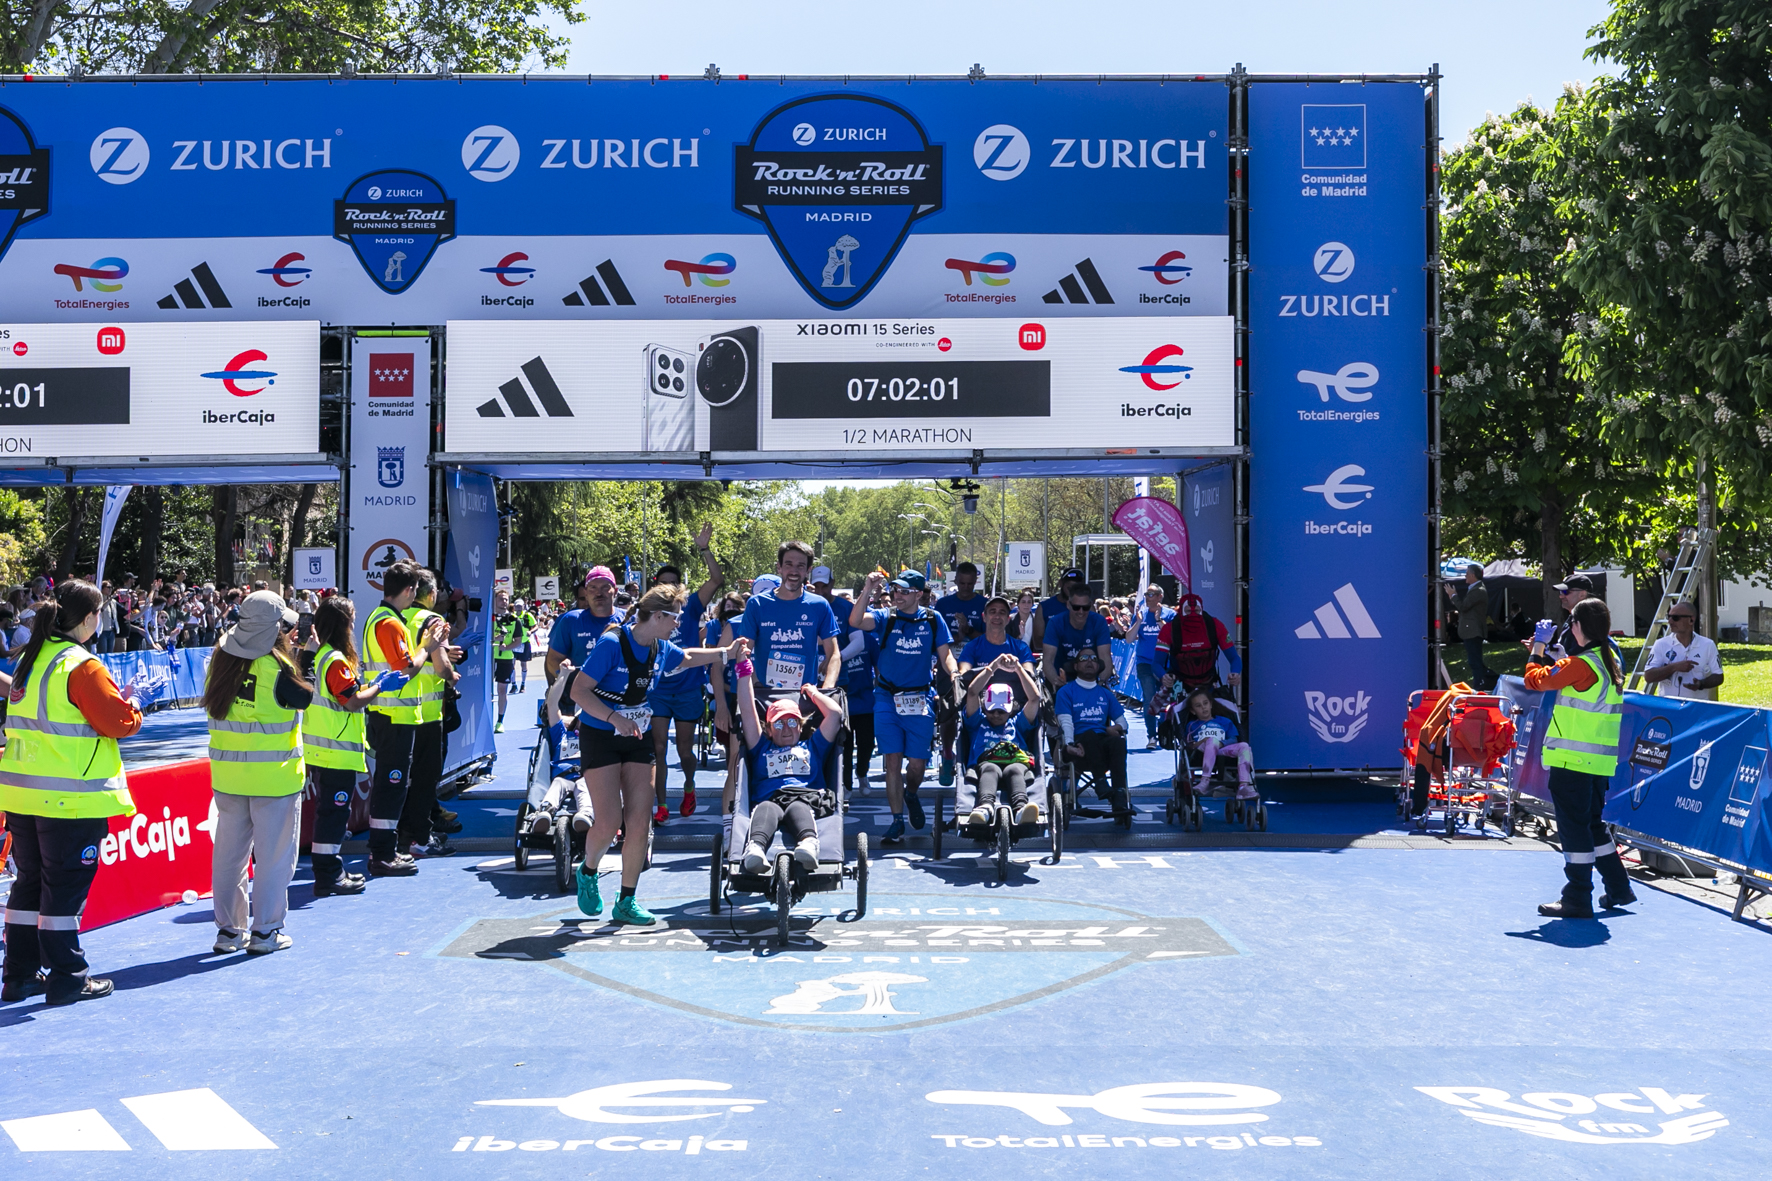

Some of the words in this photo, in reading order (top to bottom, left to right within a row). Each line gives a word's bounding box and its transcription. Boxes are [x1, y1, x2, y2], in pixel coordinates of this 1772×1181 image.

[824, 128, 886, 140] ZURICH
[170, 139, 331, 170] ZURICH
[540, 138, 699, 168] ZURICH
[1050, 139, 1205, 168] ZURICH
[1302, 174, 1366, 183] Comunidad
[768, 186, 845, 195] RUNNING
[850, 186, 910, 195] SERIES
[1302, 186, 1317, 196] de
[1322, 186, 1366, 196] Madrid
[806, 213, 872, 221] MADRID
[54, 300, 129, 310] TotalEnergies
[258, 296, 310, 308] iberCaja
[482, 295, 534, 308] iberCaja
[664, 295, 736, 305] TotalEnergies
[945, 294, 1016, 304] TotalEnergies
[1140, 294, 1190, 306] iberCaja
[1279, 295, 1389, 316] ZURICH
[873, 324, 887, 335] 15
[893, 323, 934, 335] Series
[848, 378, 957, 401] 07:02:01
[368, 401, 414, 409] Comunidad
[1121, 403, 1191, 419] iberCaja
[203, 410, 274, 426] iberCaja
[1297, 410, 1379, 422] TotalEnergies
[843, 429, 866, 443] 1/2
[874, 428, 971, 443] MARATHON
[365, 496, 416, 505] MADRID
[1201, 486, 1220, 507] ZURICH
[1306, 521, 1371, 537] iberCaja
[775, 664, 798, 674] 13567
[1304, 690, 1373, 722] Rock
[626, 710, 646, 721] 13566
[1330, 722, 1346, 734] fm
[778, 754, 799, 764] SARA
[1674, 796, 1702, 813] MADRID
[100, 806, 191, 866] erCaja
[889, 938, 1107, 947] SERIES
[1412, 1085, 1710, 1122] Rock
[1576, 1119, 1651, 1134] fm
[452, 1135, 748, 1154] iberCaja
[931, 1133, 1322, 1150] TotalEnergies
